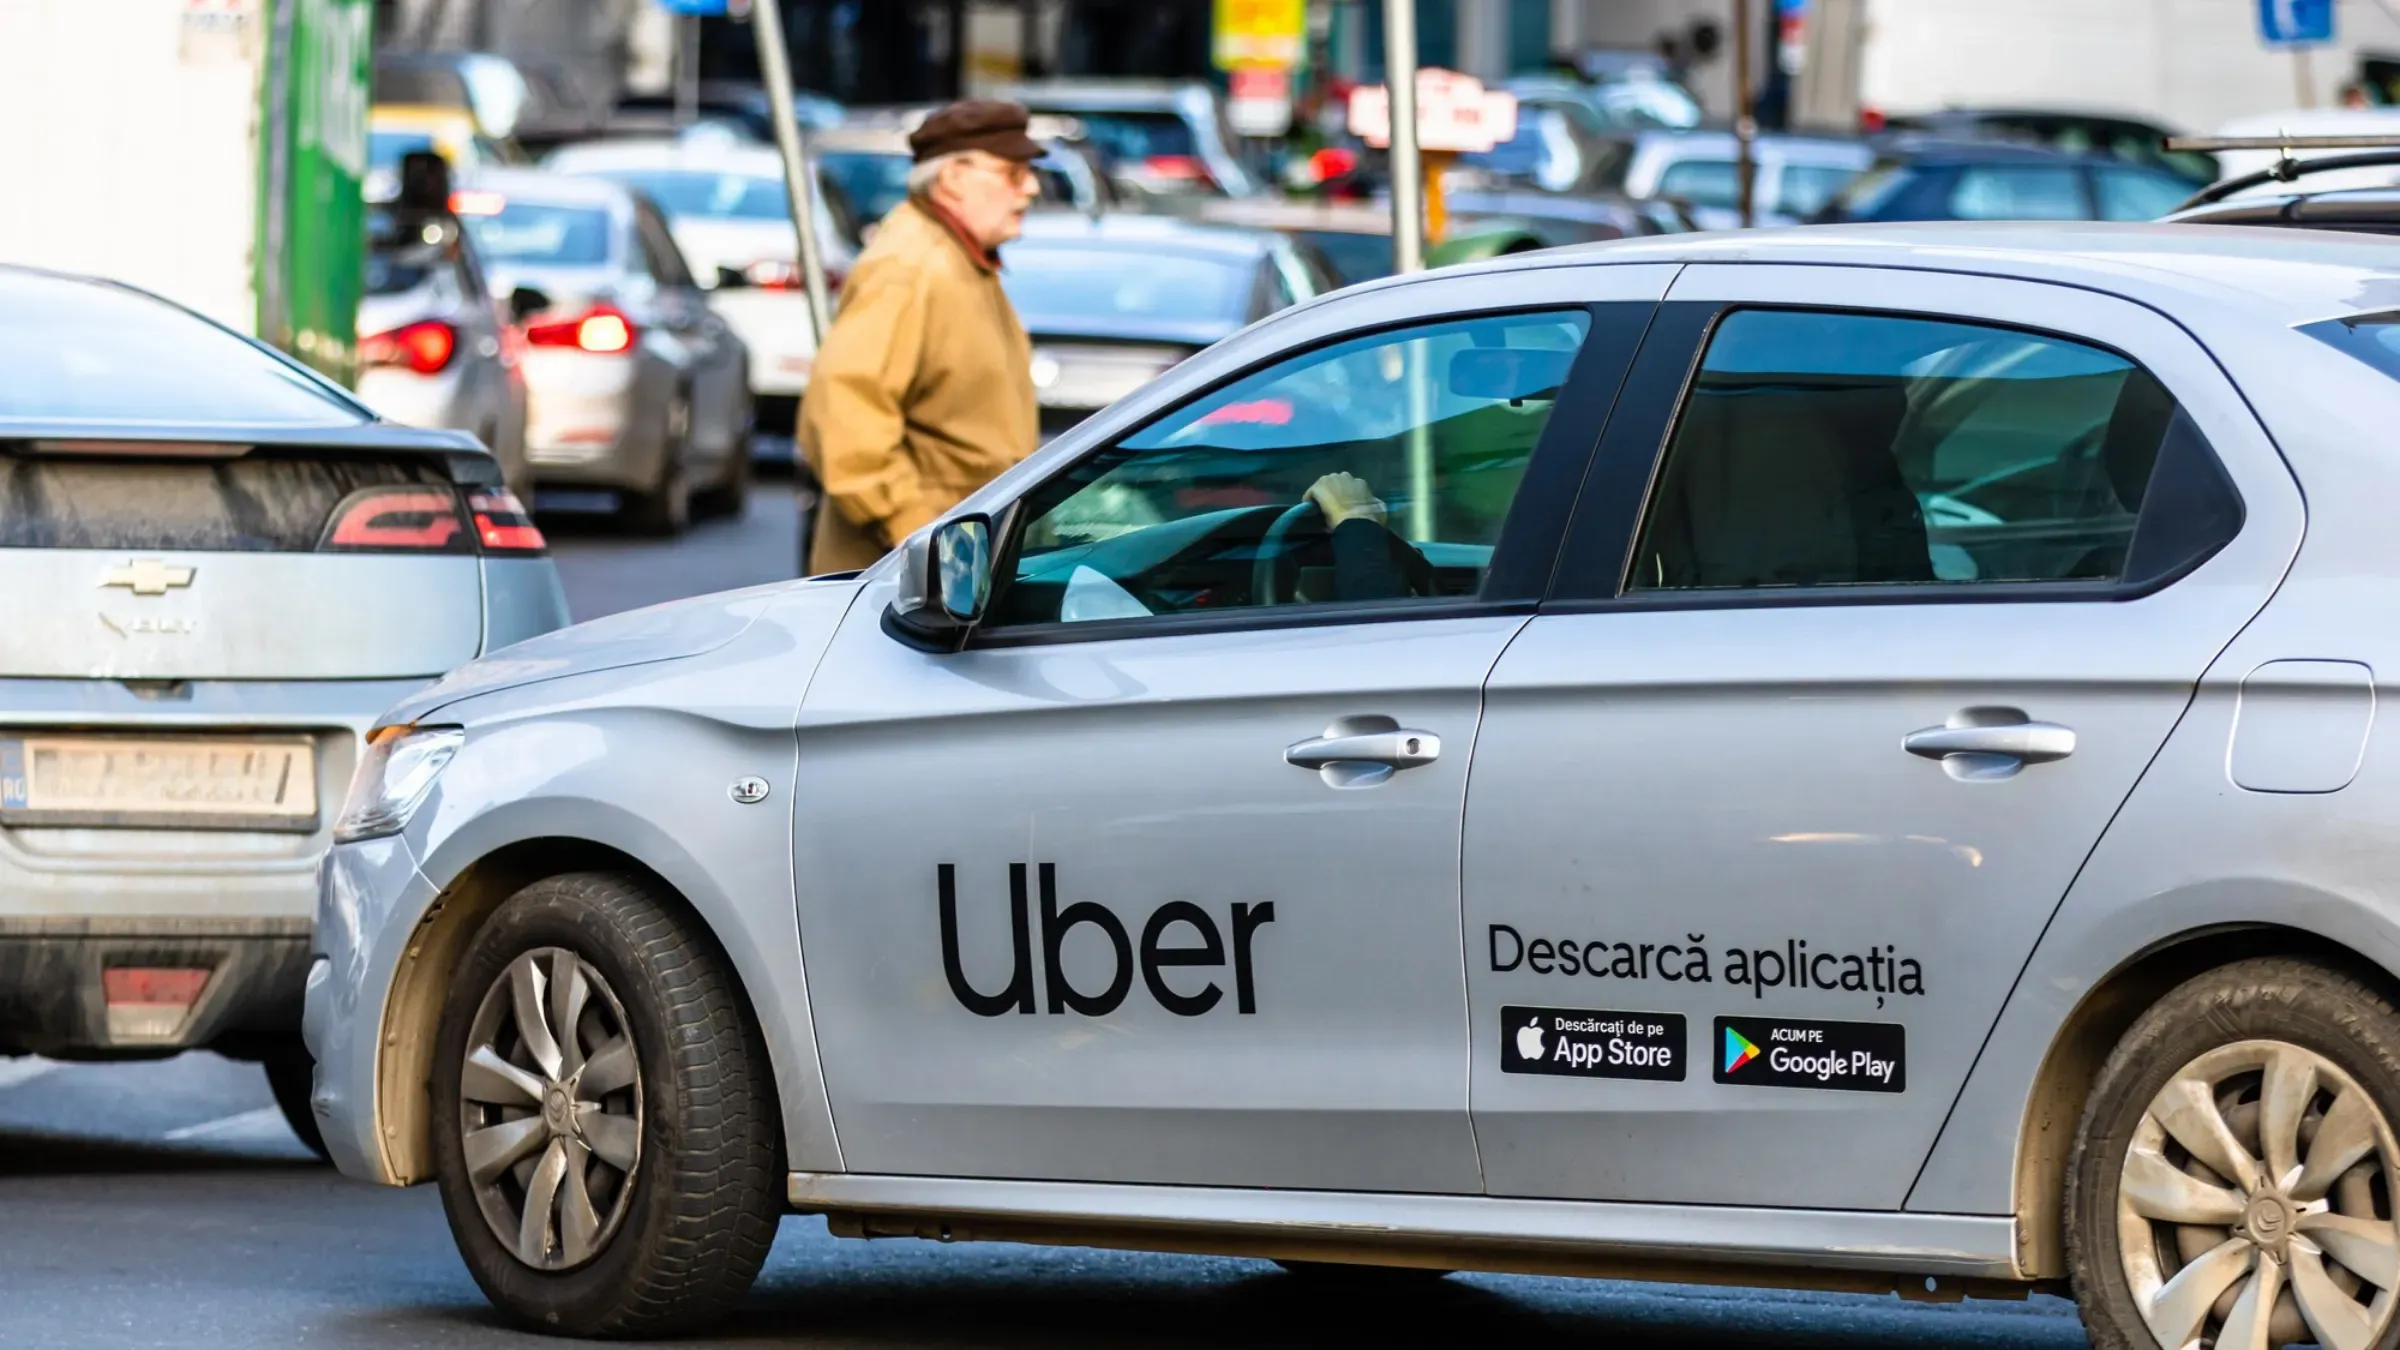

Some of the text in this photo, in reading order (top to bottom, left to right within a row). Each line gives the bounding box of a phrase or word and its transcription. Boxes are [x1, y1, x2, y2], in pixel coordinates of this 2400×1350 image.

[937, 862, 1275, 1017] Uber
[1489, 924, 1712, 982] Descarcă
[1627, 1020, 1644, 1035] de
[1647, 1024, 1664, 1037] pe
[1770, 1028, 1823, 1043] ACUM PE
[1553, 1036, 1672, 1069] App Store
[1770, 1047, 1895, 1084] Google Play
